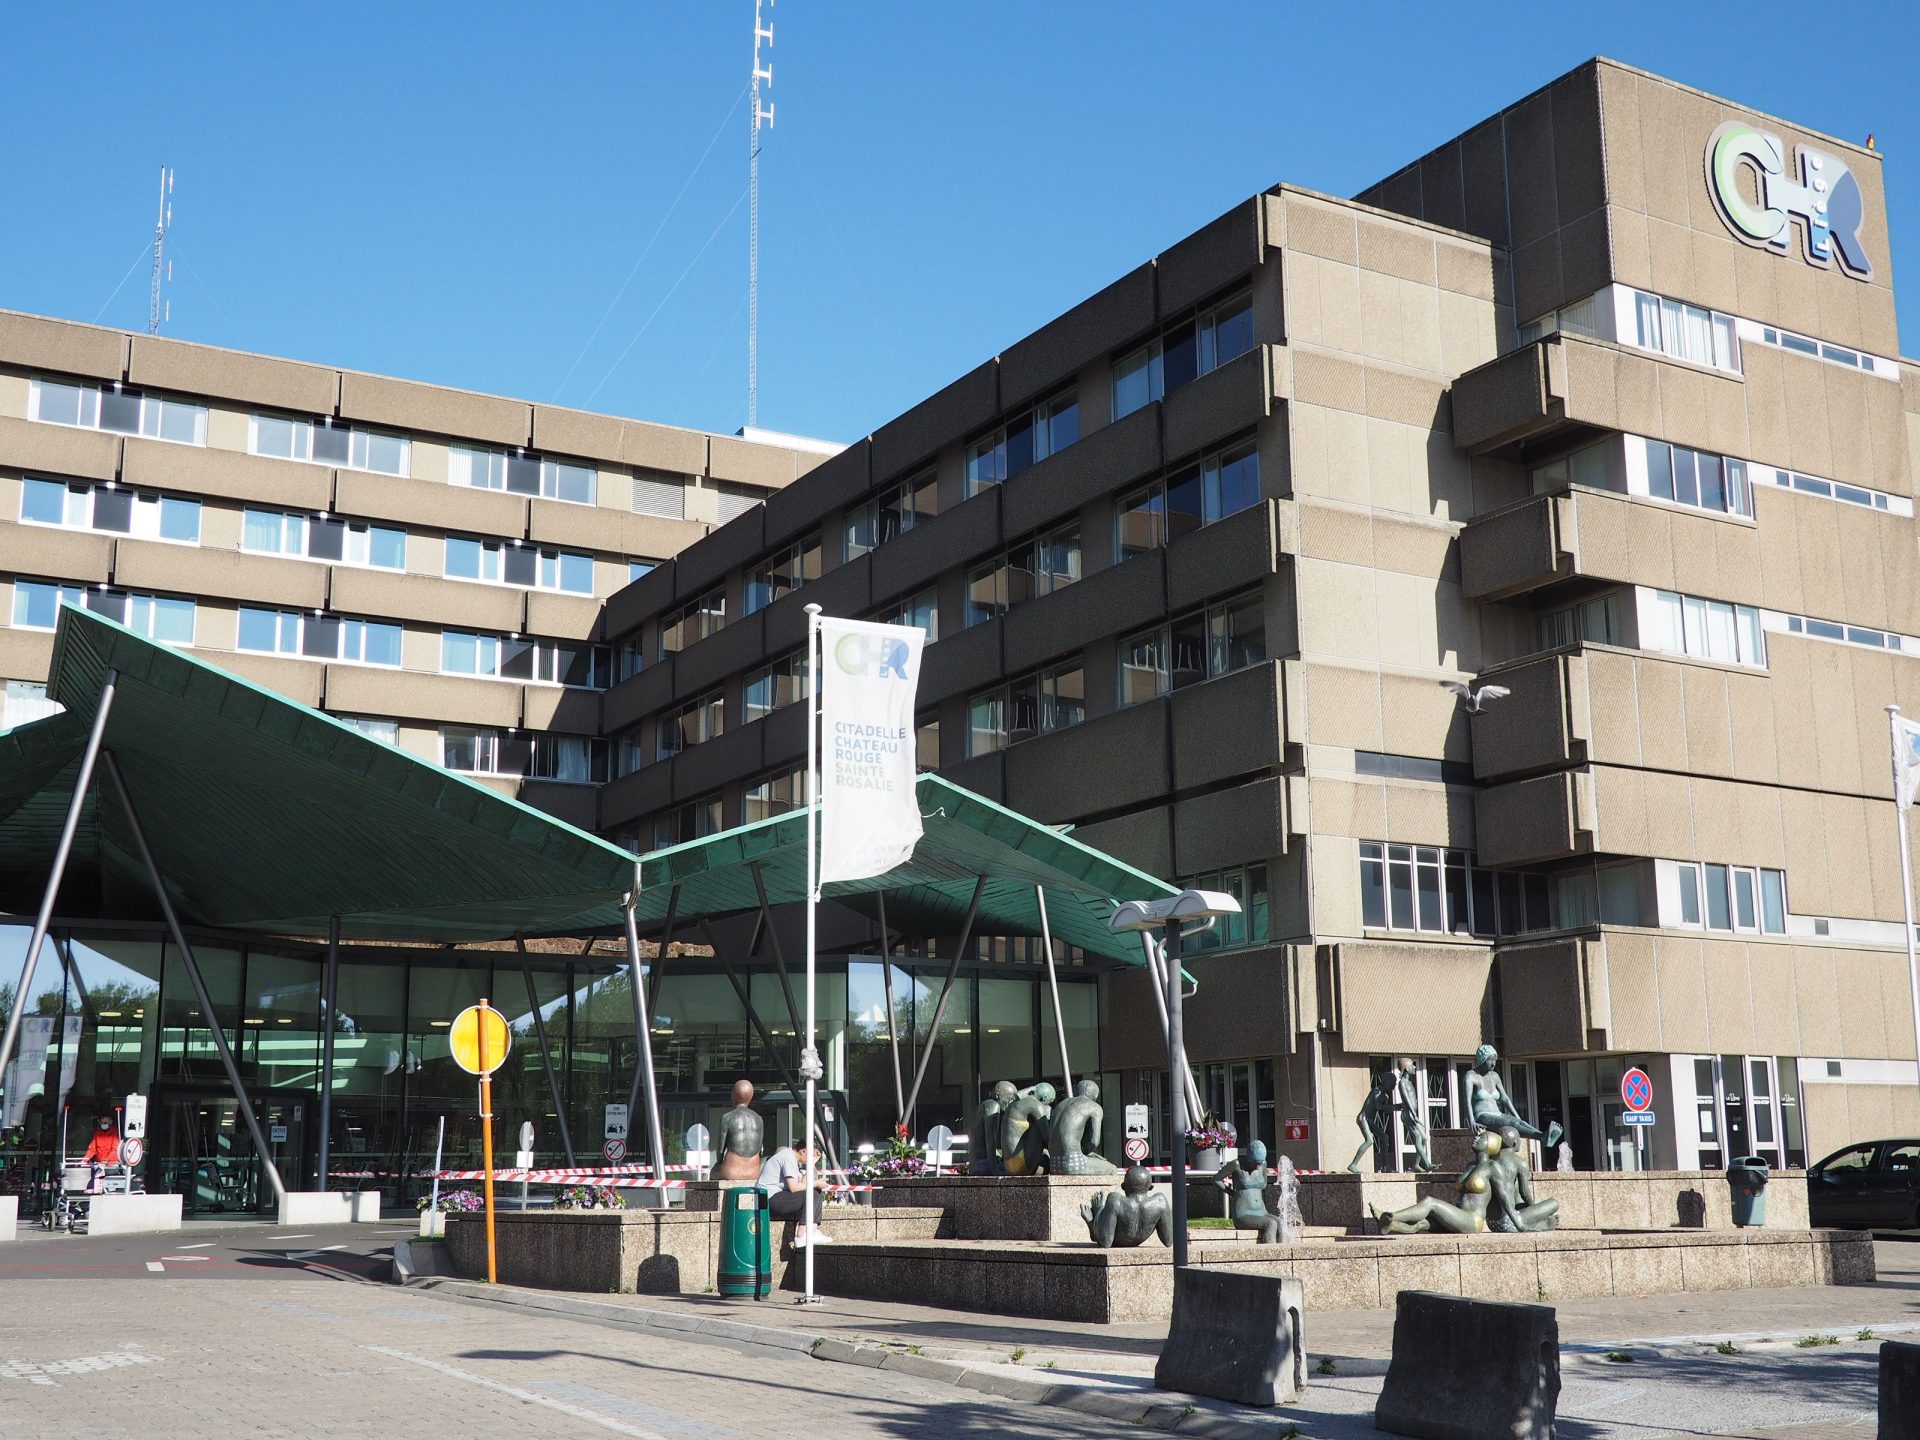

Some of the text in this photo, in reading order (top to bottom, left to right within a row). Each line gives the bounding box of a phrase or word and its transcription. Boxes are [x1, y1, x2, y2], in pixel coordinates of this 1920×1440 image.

[1705, 121, 1873, 281] CHR
[835, 633, 909, 680] CHR
[835, 721, 906, 740] CITADELLE
[835, 735, 898, 753] CHATEAU
[835, 748, 882, 764] ROUGE
[835, 762, 885, 778] SAINTE
[836, 774, 895, 792] ROSALIE
